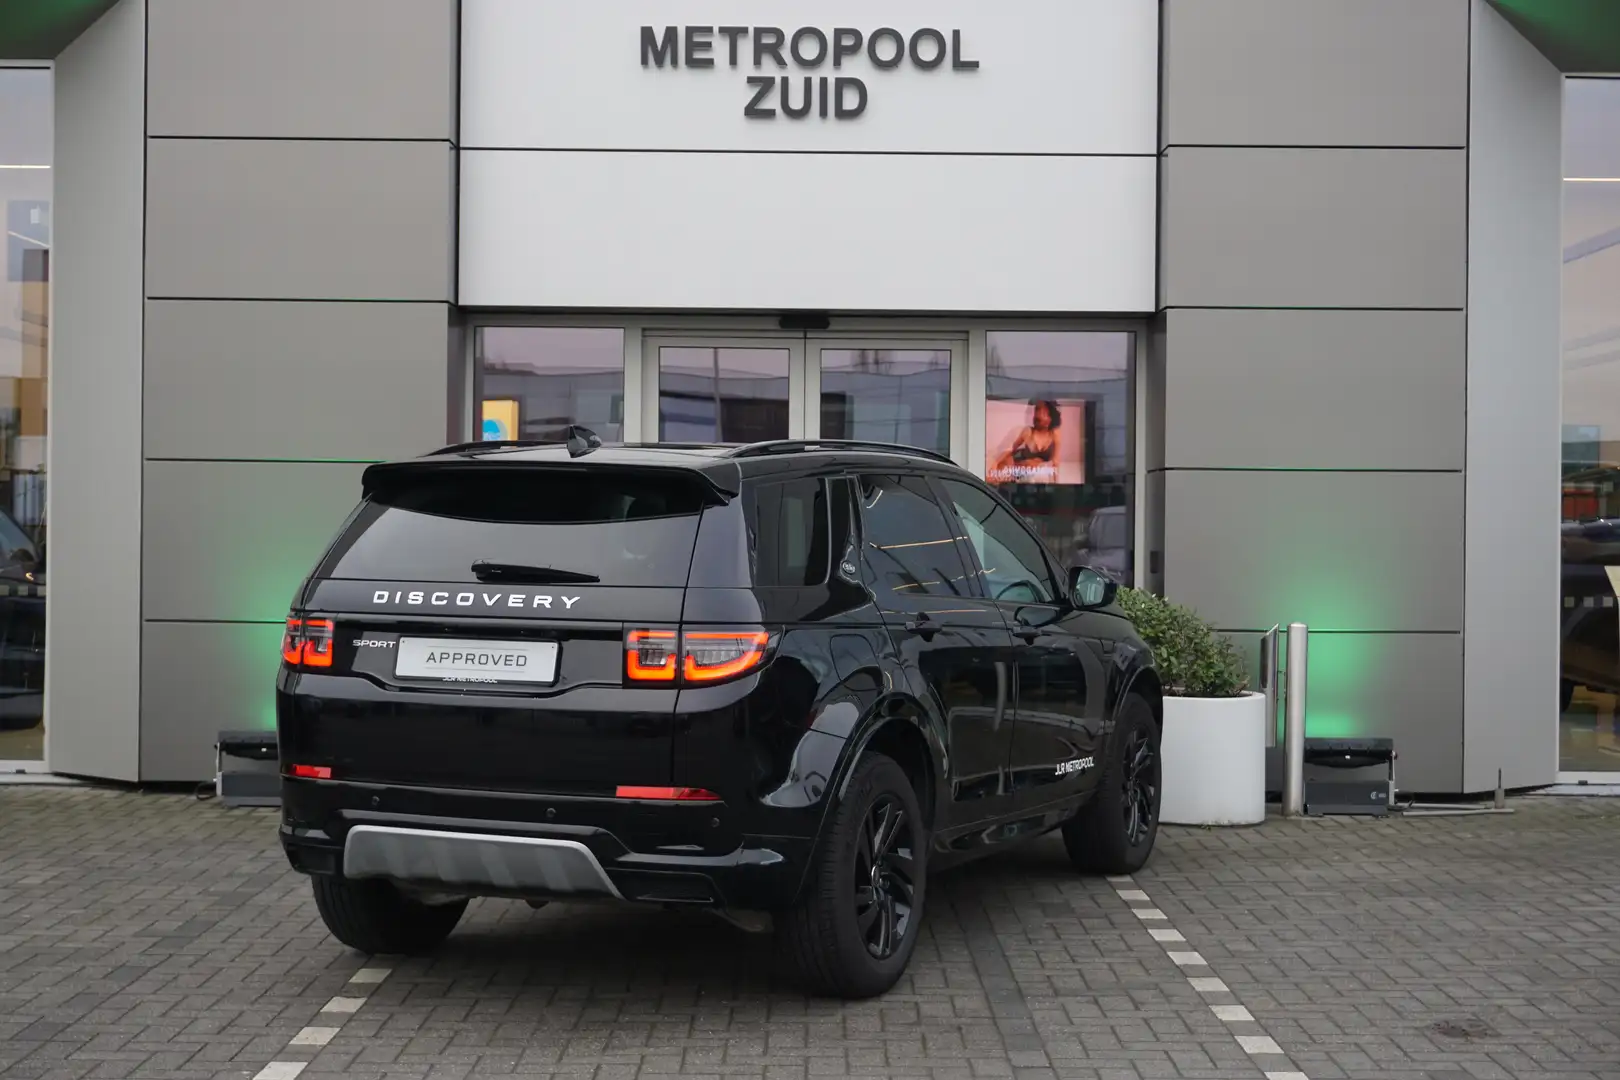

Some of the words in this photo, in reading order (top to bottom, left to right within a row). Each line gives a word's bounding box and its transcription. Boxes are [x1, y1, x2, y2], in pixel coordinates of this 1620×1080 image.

[640, 26, 980, 69] METROPOOL
[744, 76, 868, 118] ZUID
[373, 590, 581, 609] DISCOVERY
[352, 639, 396, 648] SPORT
[426, 651, 527, 667] APPROVED
[1055, 763, 1065, 776] JLR
[1065, 756, 1095, 773] METROPOOL
